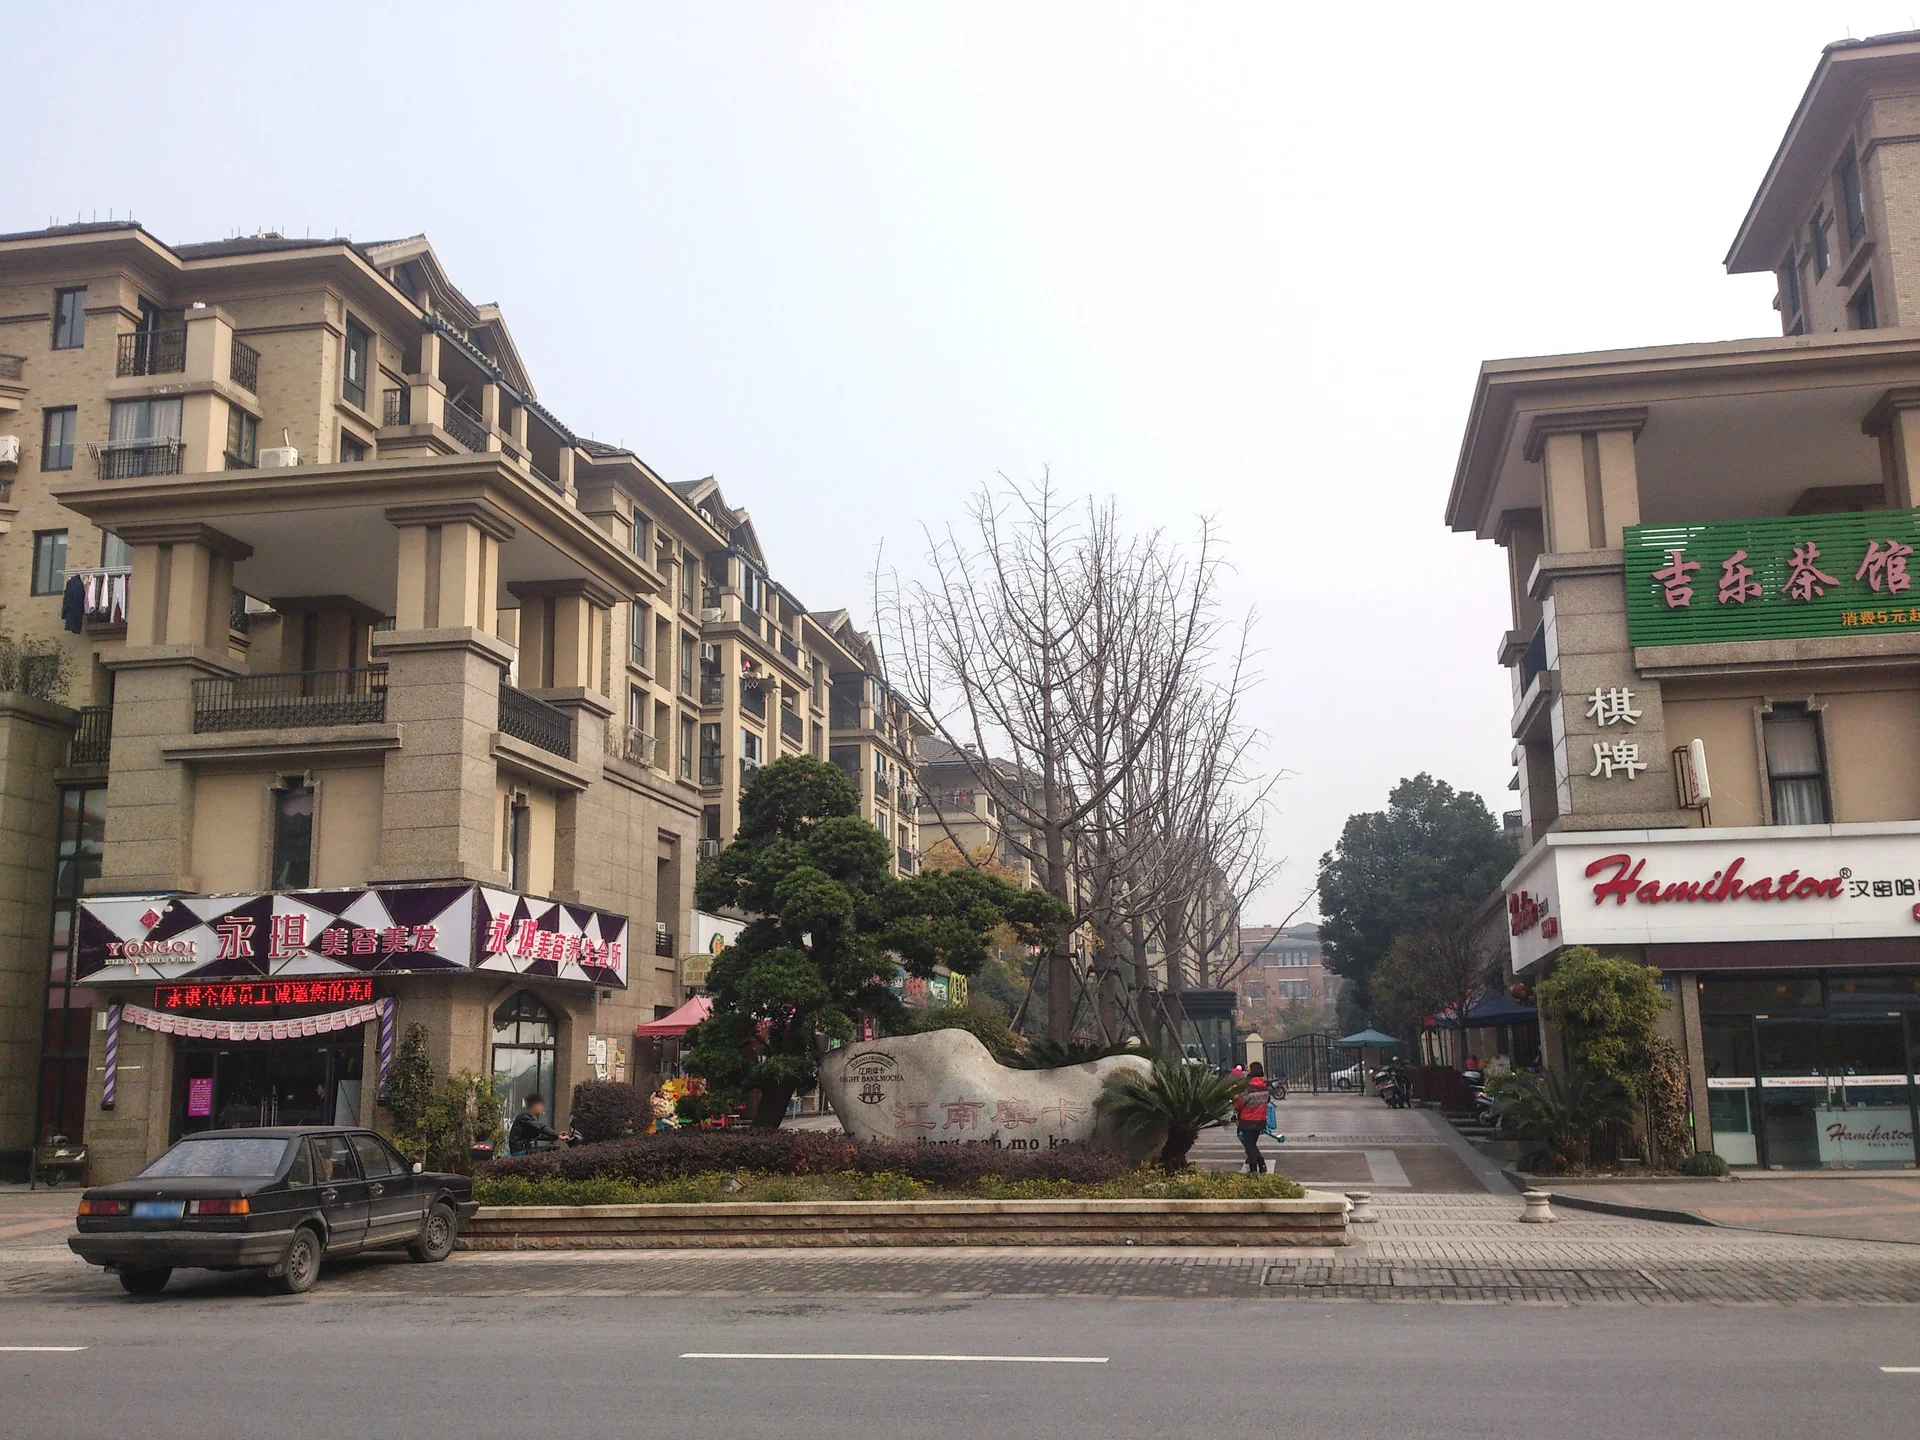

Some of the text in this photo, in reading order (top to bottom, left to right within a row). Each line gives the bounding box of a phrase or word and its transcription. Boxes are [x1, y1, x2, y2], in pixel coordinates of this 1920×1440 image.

[1651, 540, 1914, 609] 吉乐茶馆
[1586, 687, 1648, 779] 棋牌
[1585, 853, 1844, 905] Hamihaton
[1849, 878, 1920, 898] 汉密哈
[106, 938, 197, 959] YONGQI
[320, 925, 439, 955] 美容美发
[892, 1096, 1088, 1130] 江南摩卡
[1012, 1138, 1040, 1150] mo
